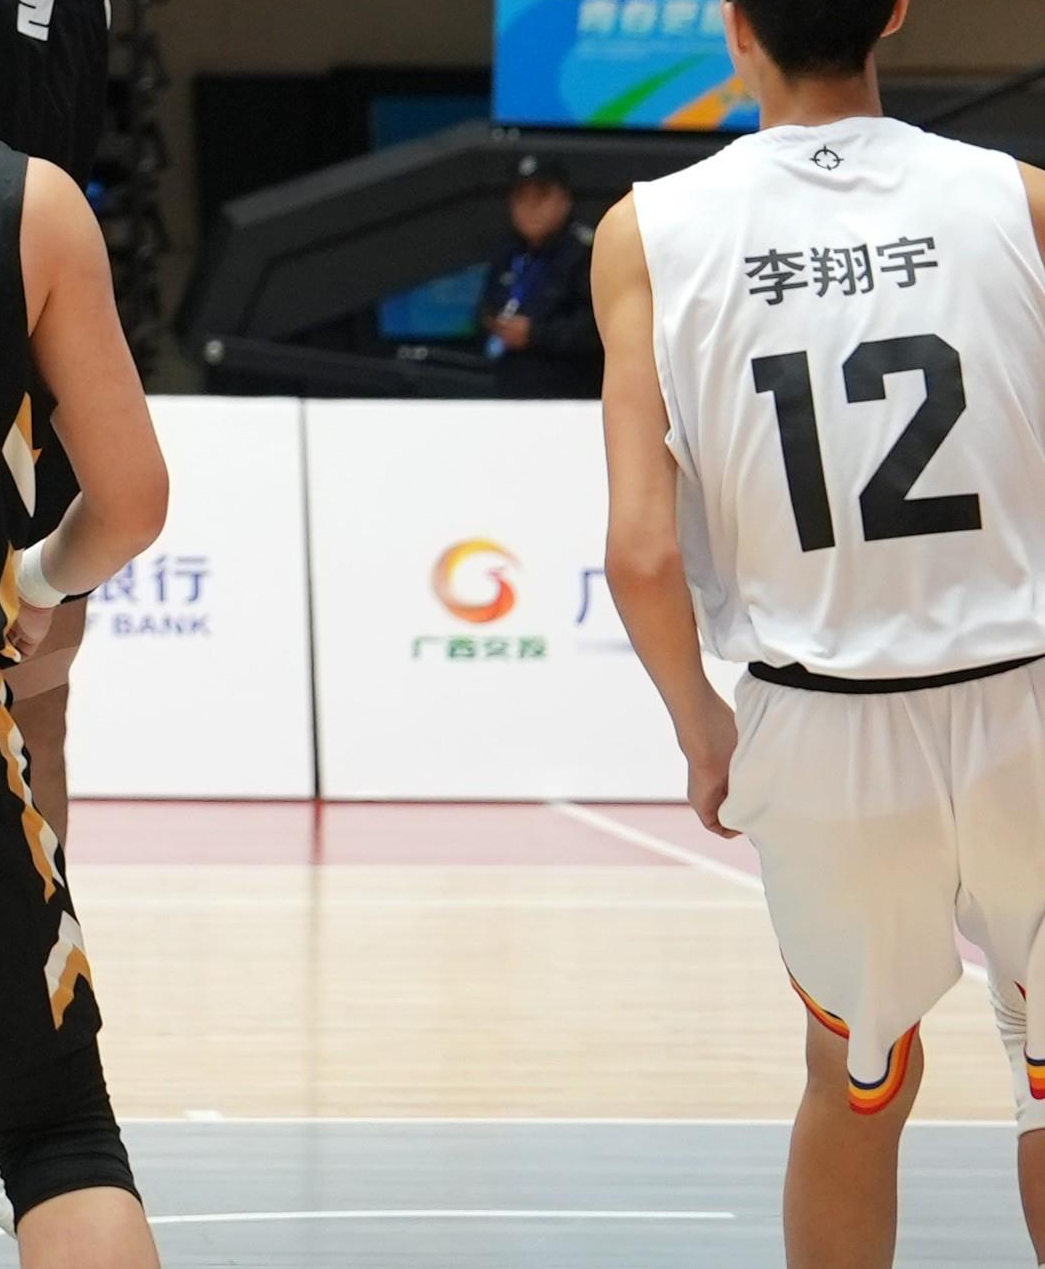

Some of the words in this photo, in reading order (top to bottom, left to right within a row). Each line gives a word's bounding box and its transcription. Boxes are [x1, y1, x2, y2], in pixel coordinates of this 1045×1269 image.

[744, 236, 938, 306] 李翔宇
[751, 333, 982, 553] 12
[112, 614, 211, 634] BANK
